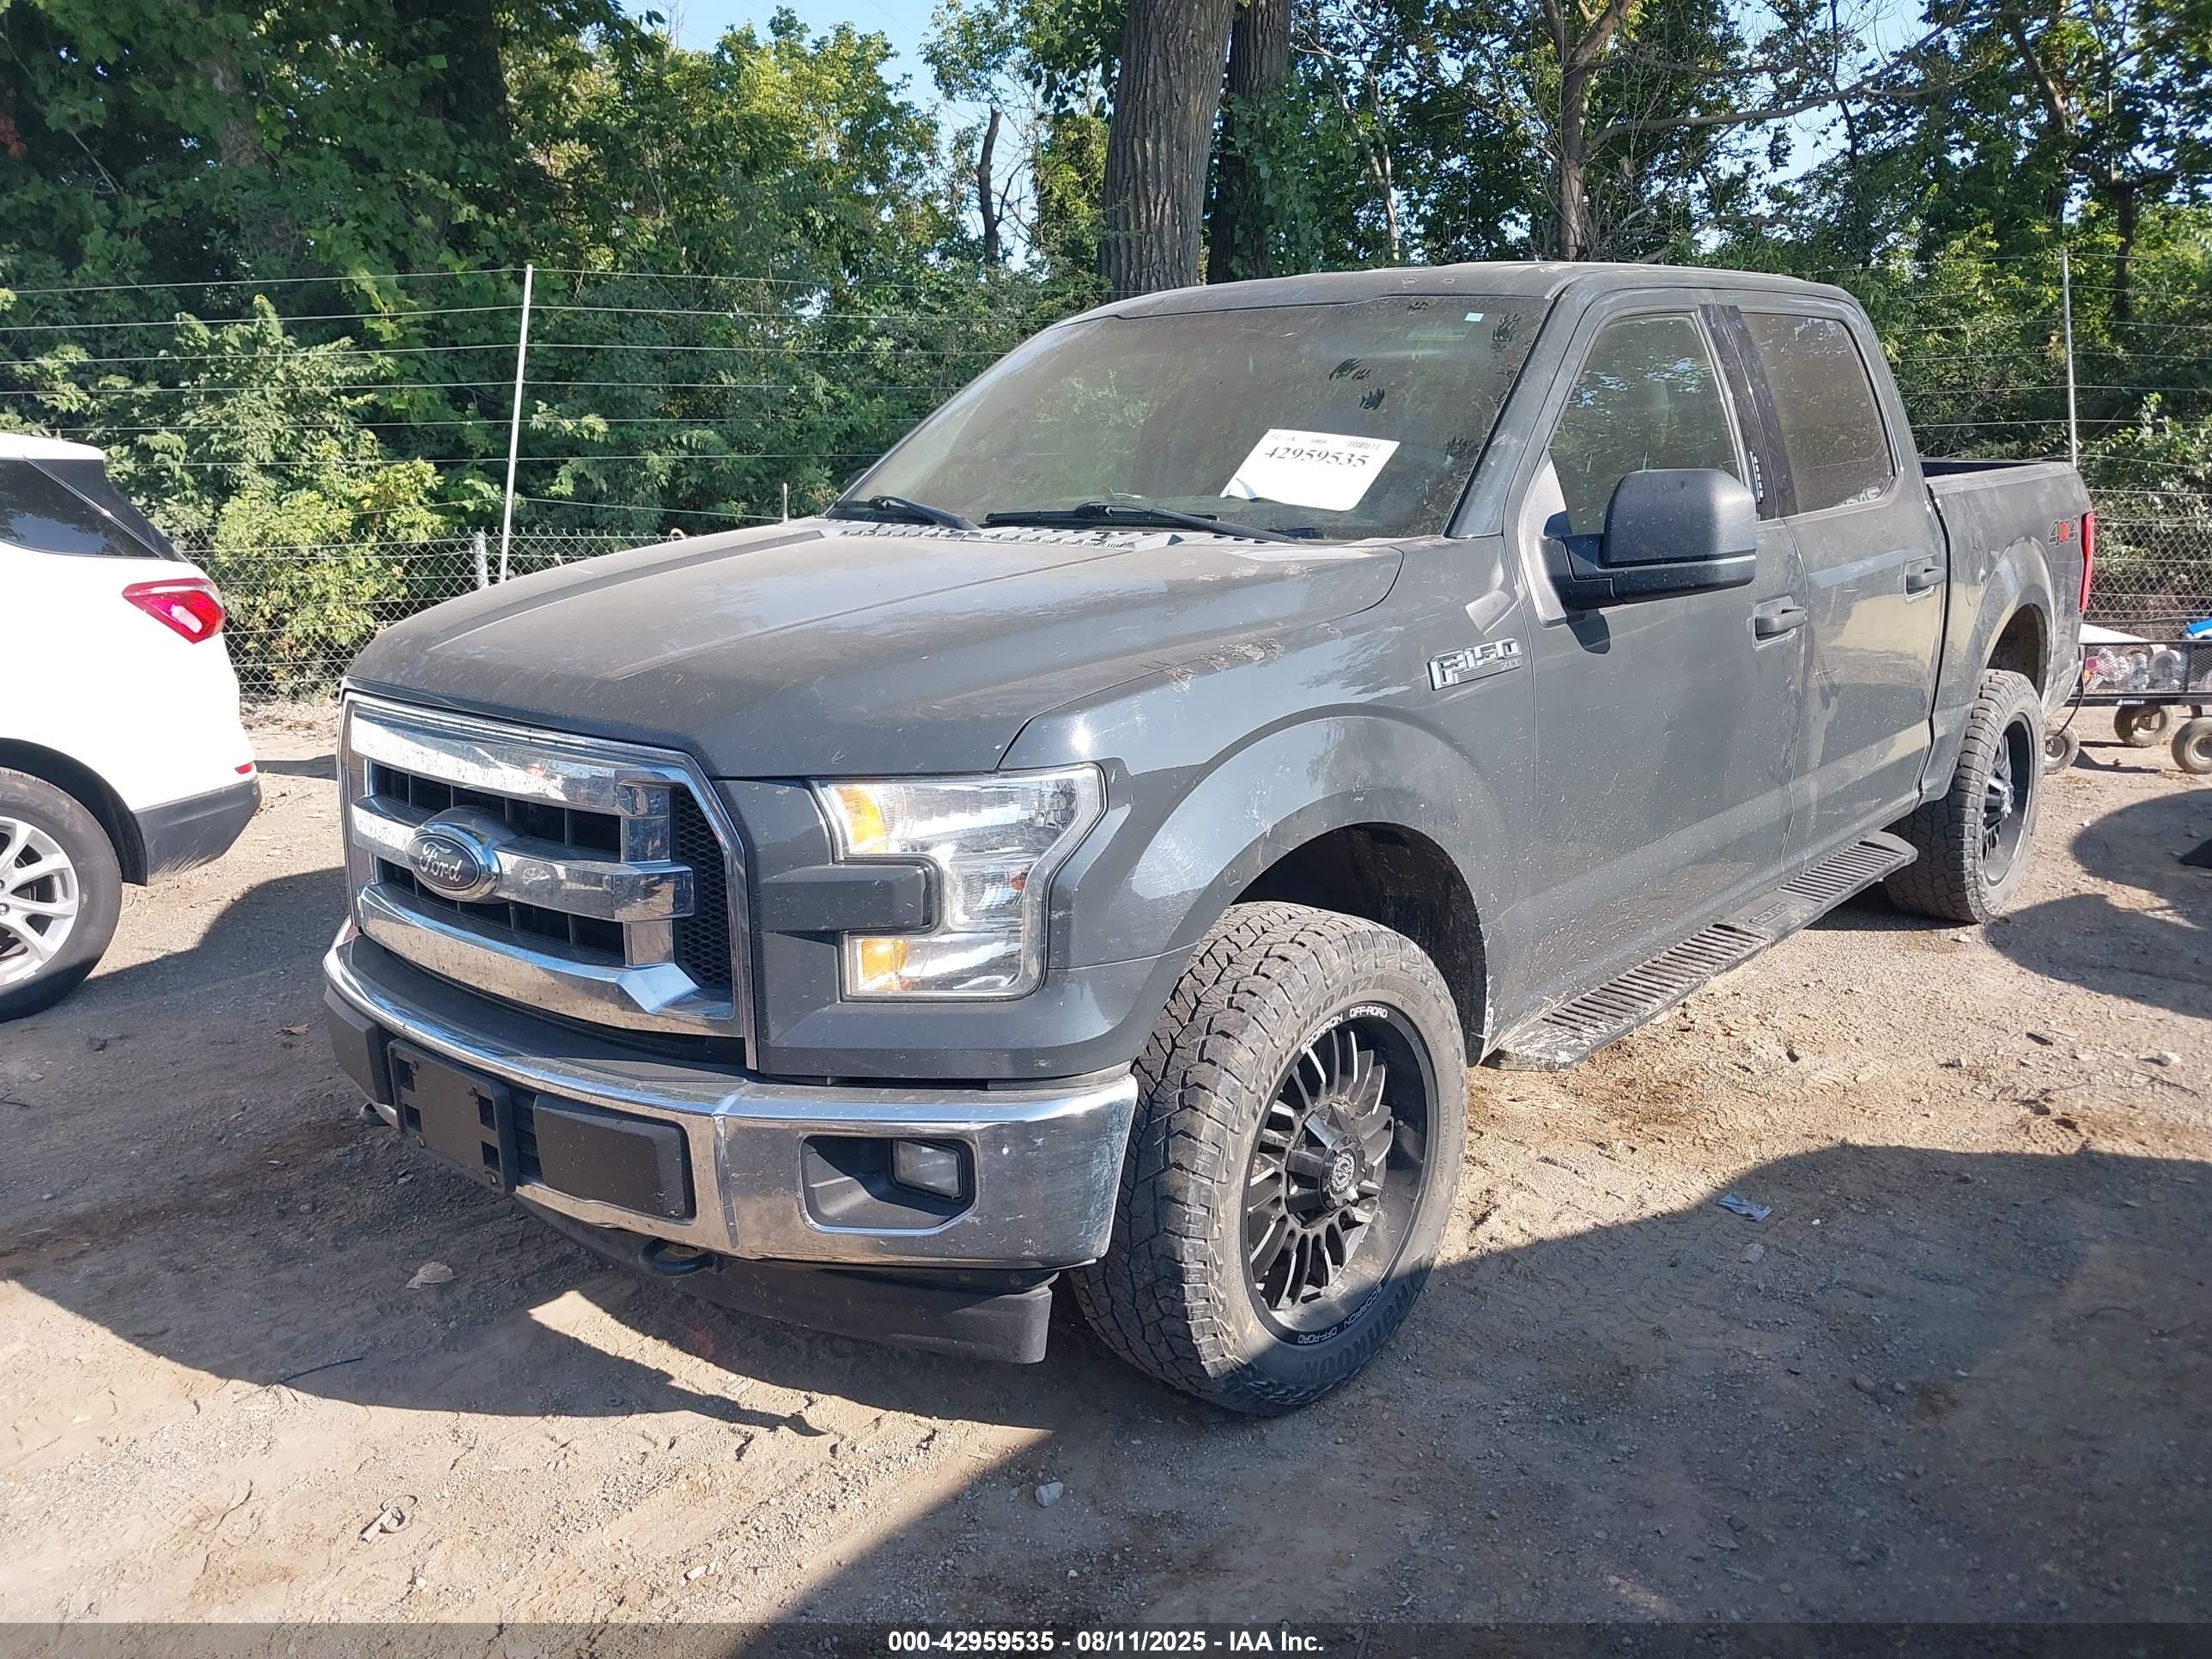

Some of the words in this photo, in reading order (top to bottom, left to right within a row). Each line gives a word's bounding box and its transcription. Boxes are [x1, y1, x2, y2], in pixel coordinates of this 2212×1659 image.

[1265, 446, 1370, 468] 42959535
[419, 841, 463, 882] Ford
[1299, 1012, 1344, 1054] SCORPION
[1349, 1006, 1388, 1019] OFF-ROAD
[1342, 1282, 1383, 1331] SCORPION
[1297, 1325, 1339, 1345] OFF-ROAD
